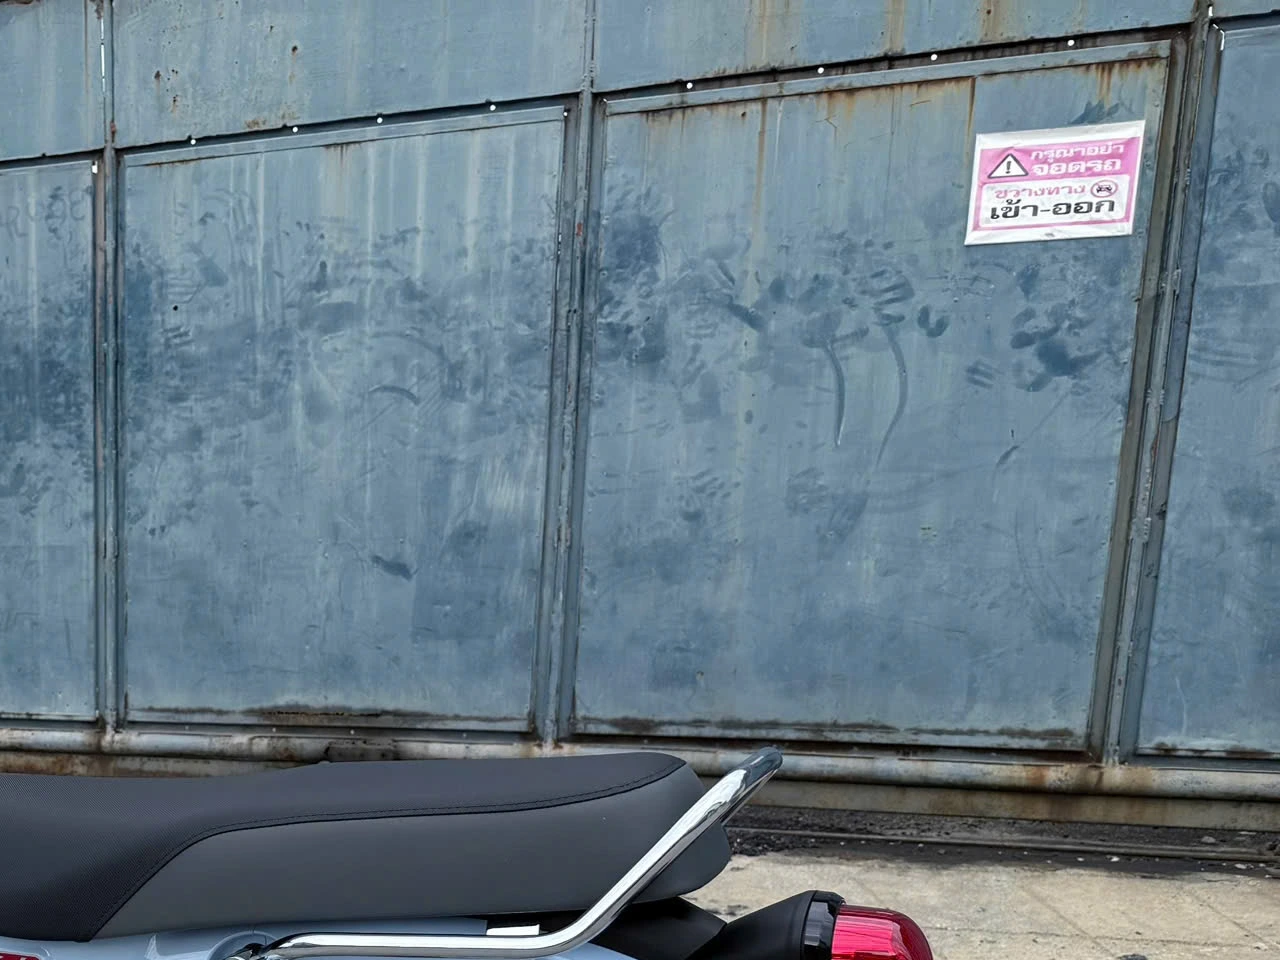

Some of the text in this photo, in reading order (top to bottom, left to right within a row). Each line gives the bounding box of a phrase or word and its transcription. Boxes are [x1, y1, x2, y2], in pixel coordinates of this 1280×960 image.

[1031, 142, 1125, 162] กรุณาอย่า
[1032, 158, 1122, 176] จอดรถ
[994, 184, 1086, 200] ขวางทาง
[990, 198, 1116, 220] เข้า-ออก
